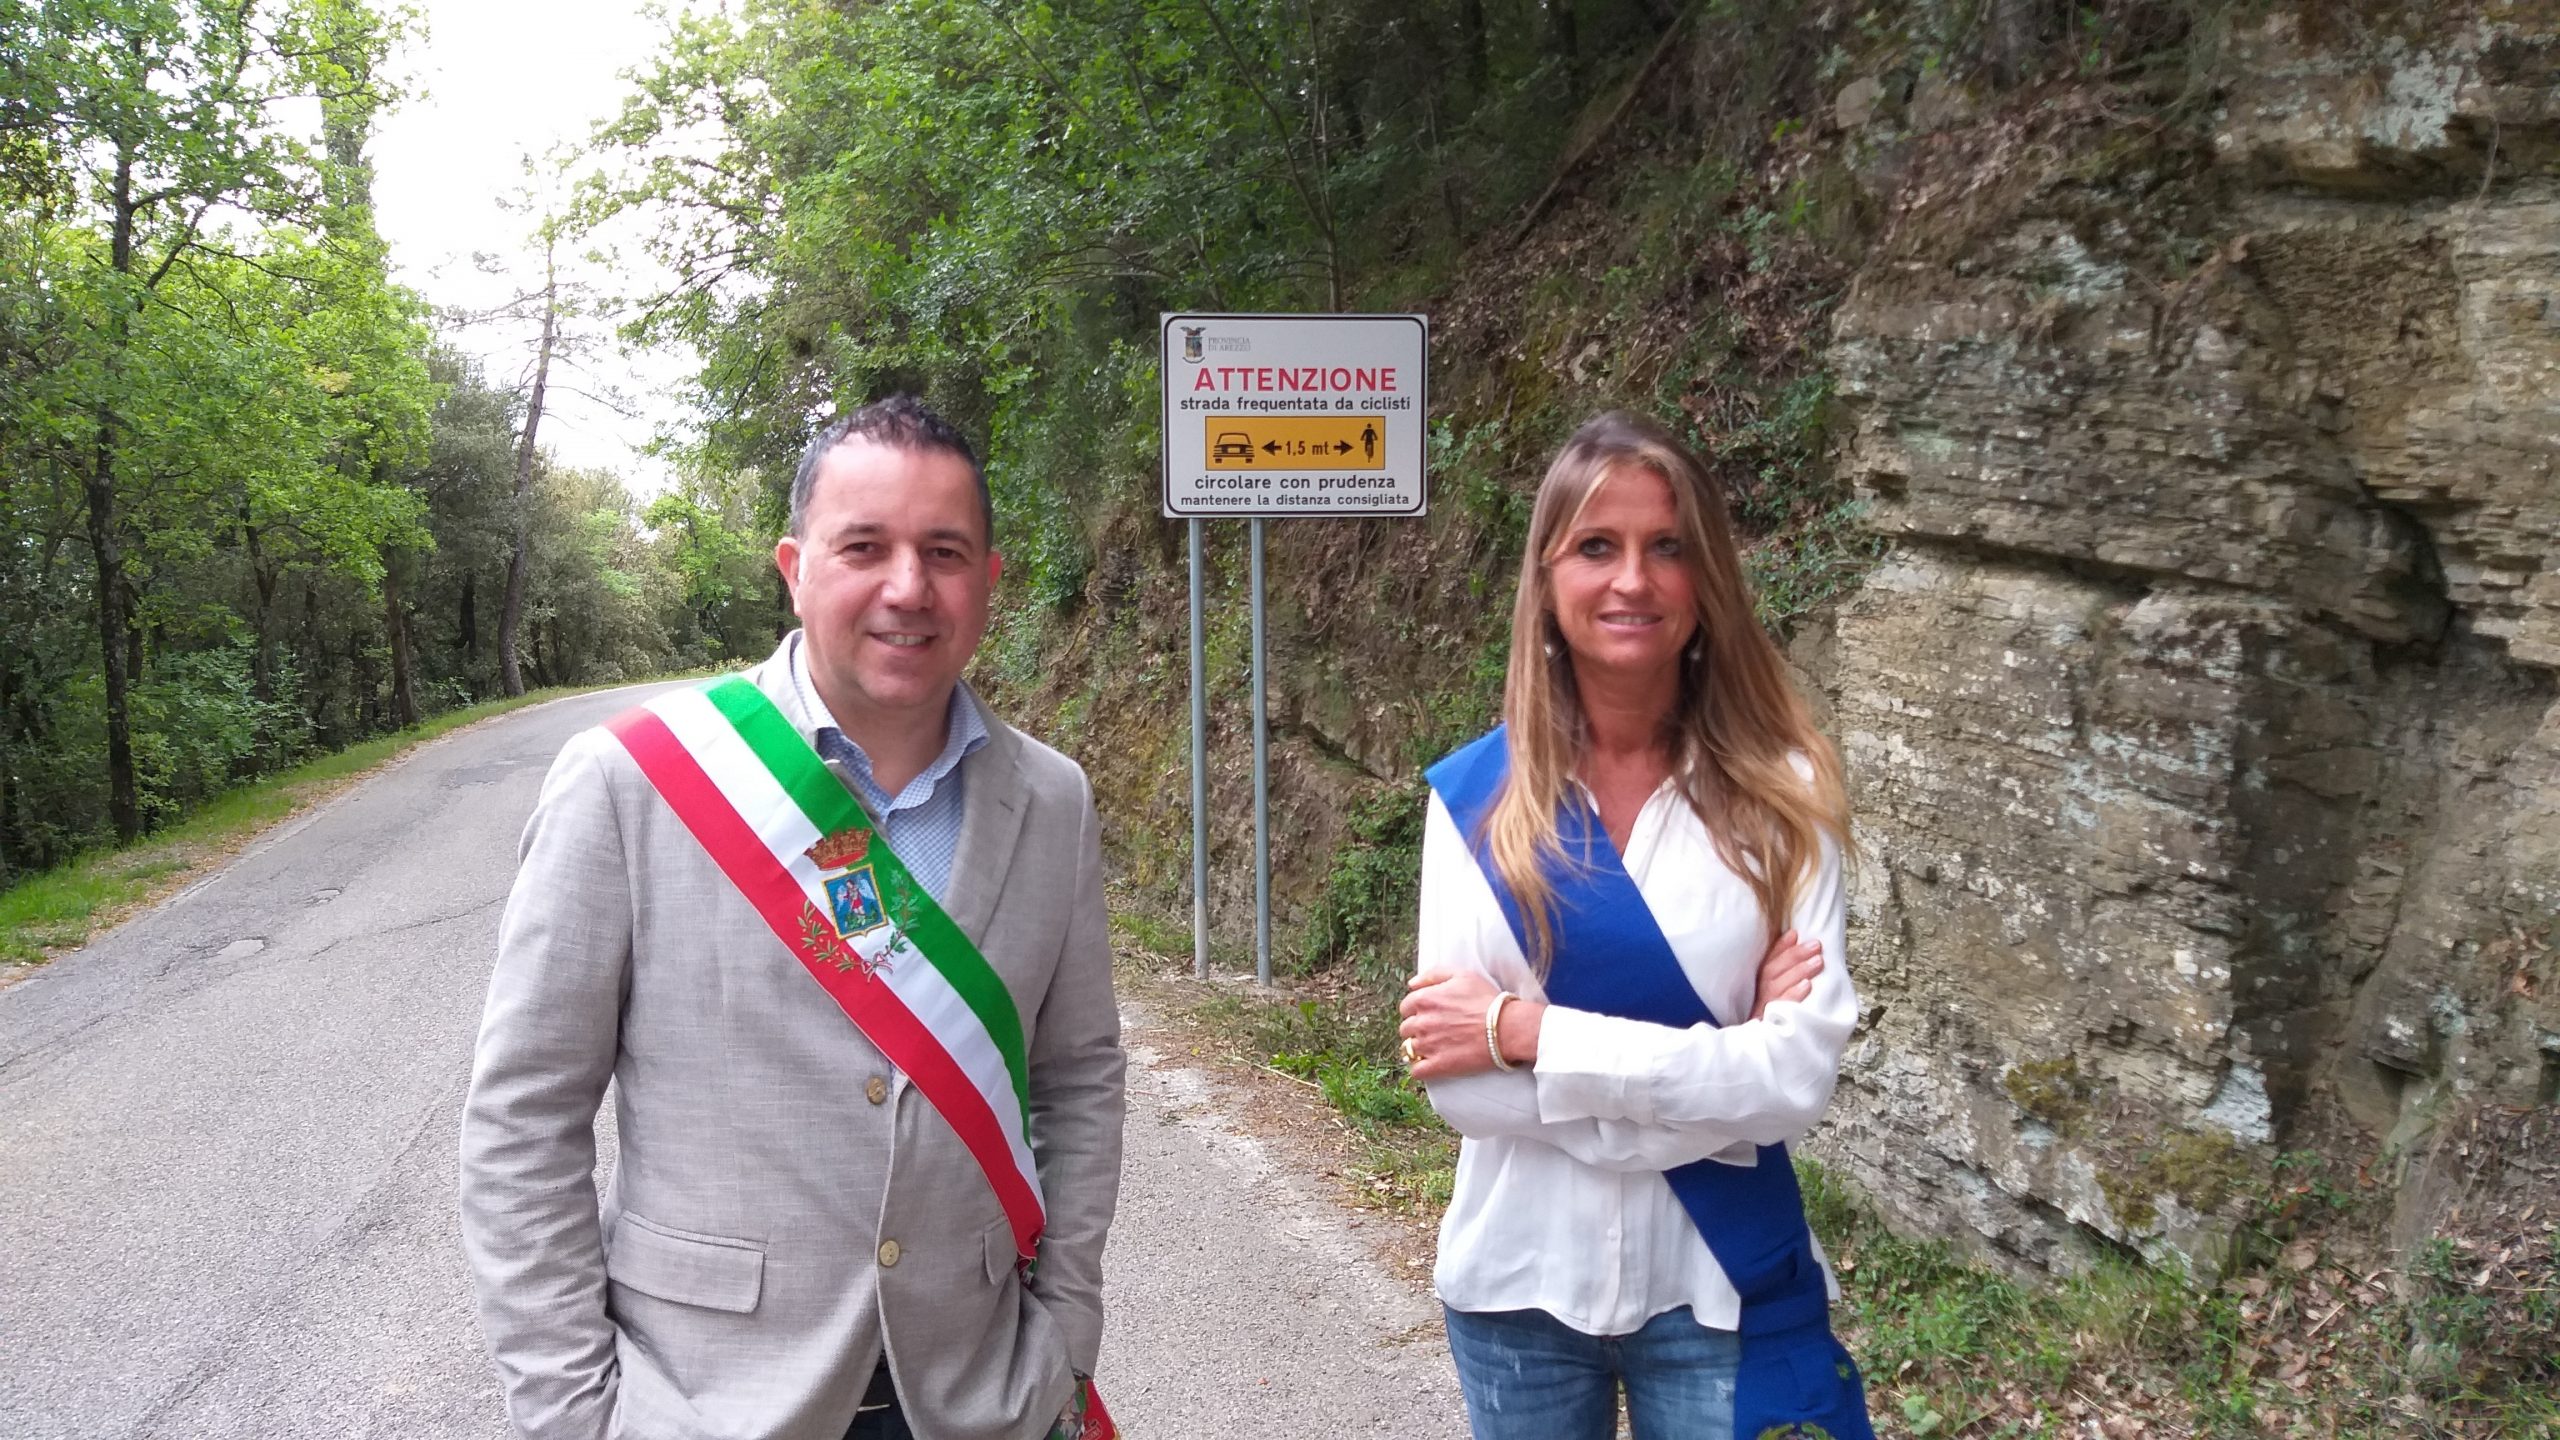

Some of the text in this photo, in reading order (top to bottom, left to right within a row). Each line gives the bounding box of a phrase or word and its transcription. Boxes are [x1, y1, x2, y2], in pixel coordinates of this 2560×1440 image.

[1194, 367, 1397, 392] ATTENZIONE
[1180, 396, 1411, 413] strada frequentata da ciclisti
[1311, 440, 1329, 456] mt
[1194, 474, 1396, 491] circolare con prudenza
[1181, 494, 1409, 507] mantenere la distanza consigliata
